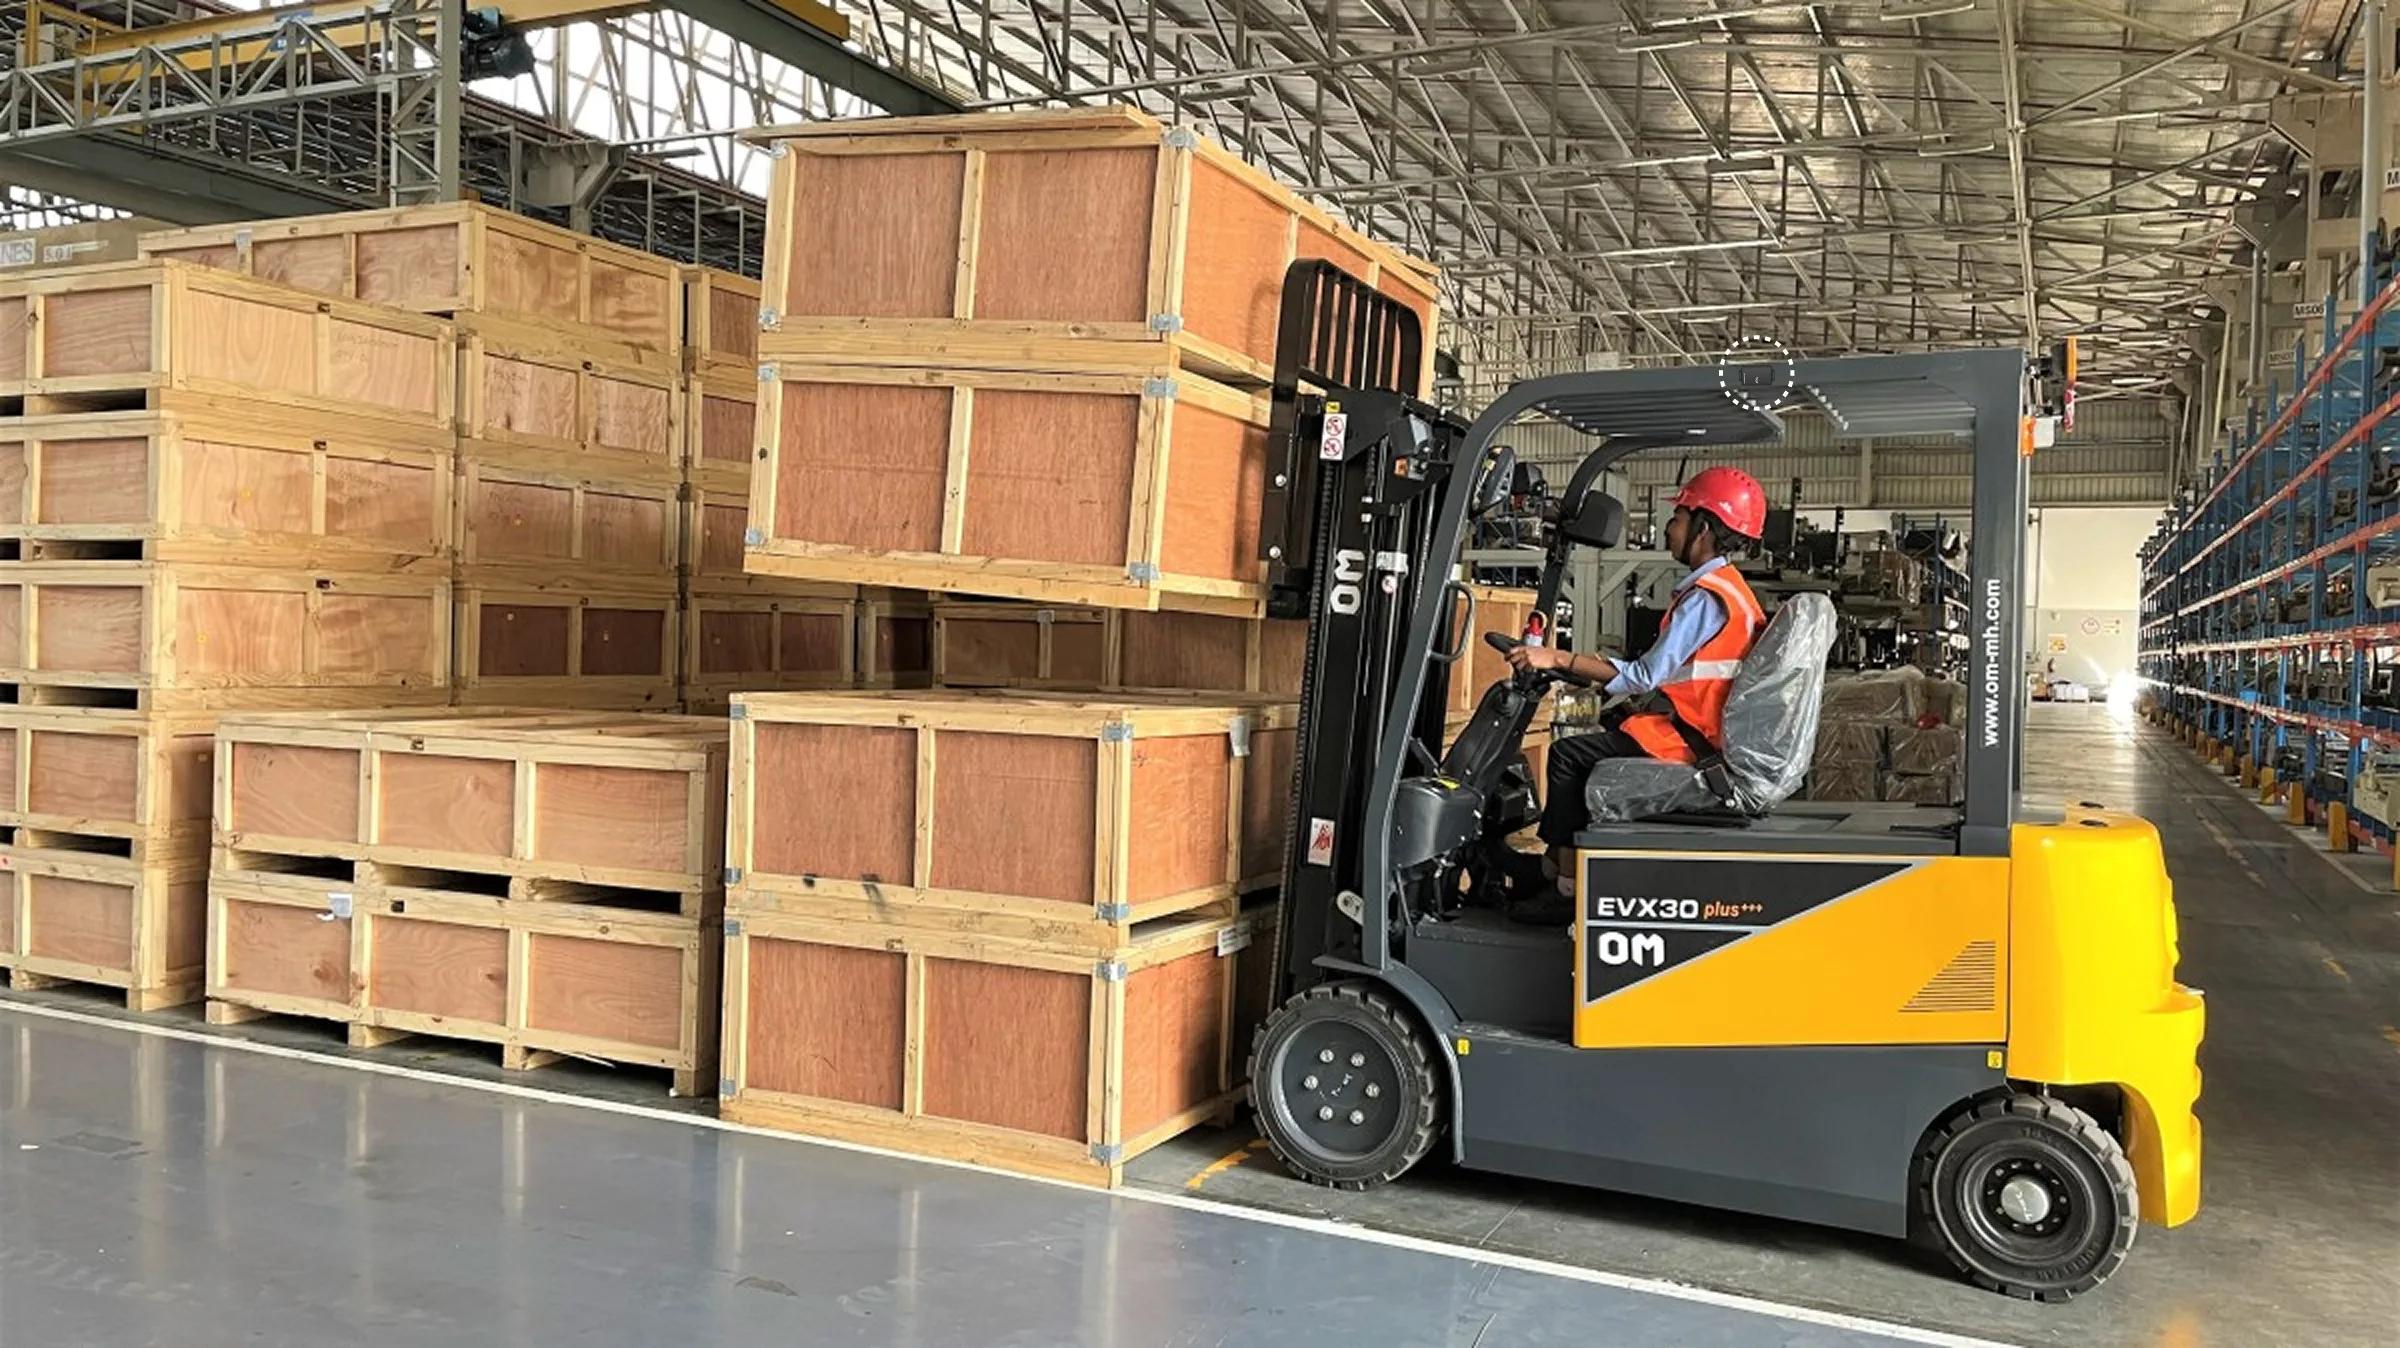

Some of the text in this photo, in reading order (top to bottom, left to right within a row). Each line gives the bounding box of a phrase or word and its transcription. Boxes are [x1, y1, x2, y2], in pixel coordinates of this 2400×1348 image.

[1330, 549, 1365, 615] OM
[1982, 579, 2001, 747] www.om-mh.com
[1597, 897, 1699, 919] EVX30
[1598, 931, 1665, 967] OM
